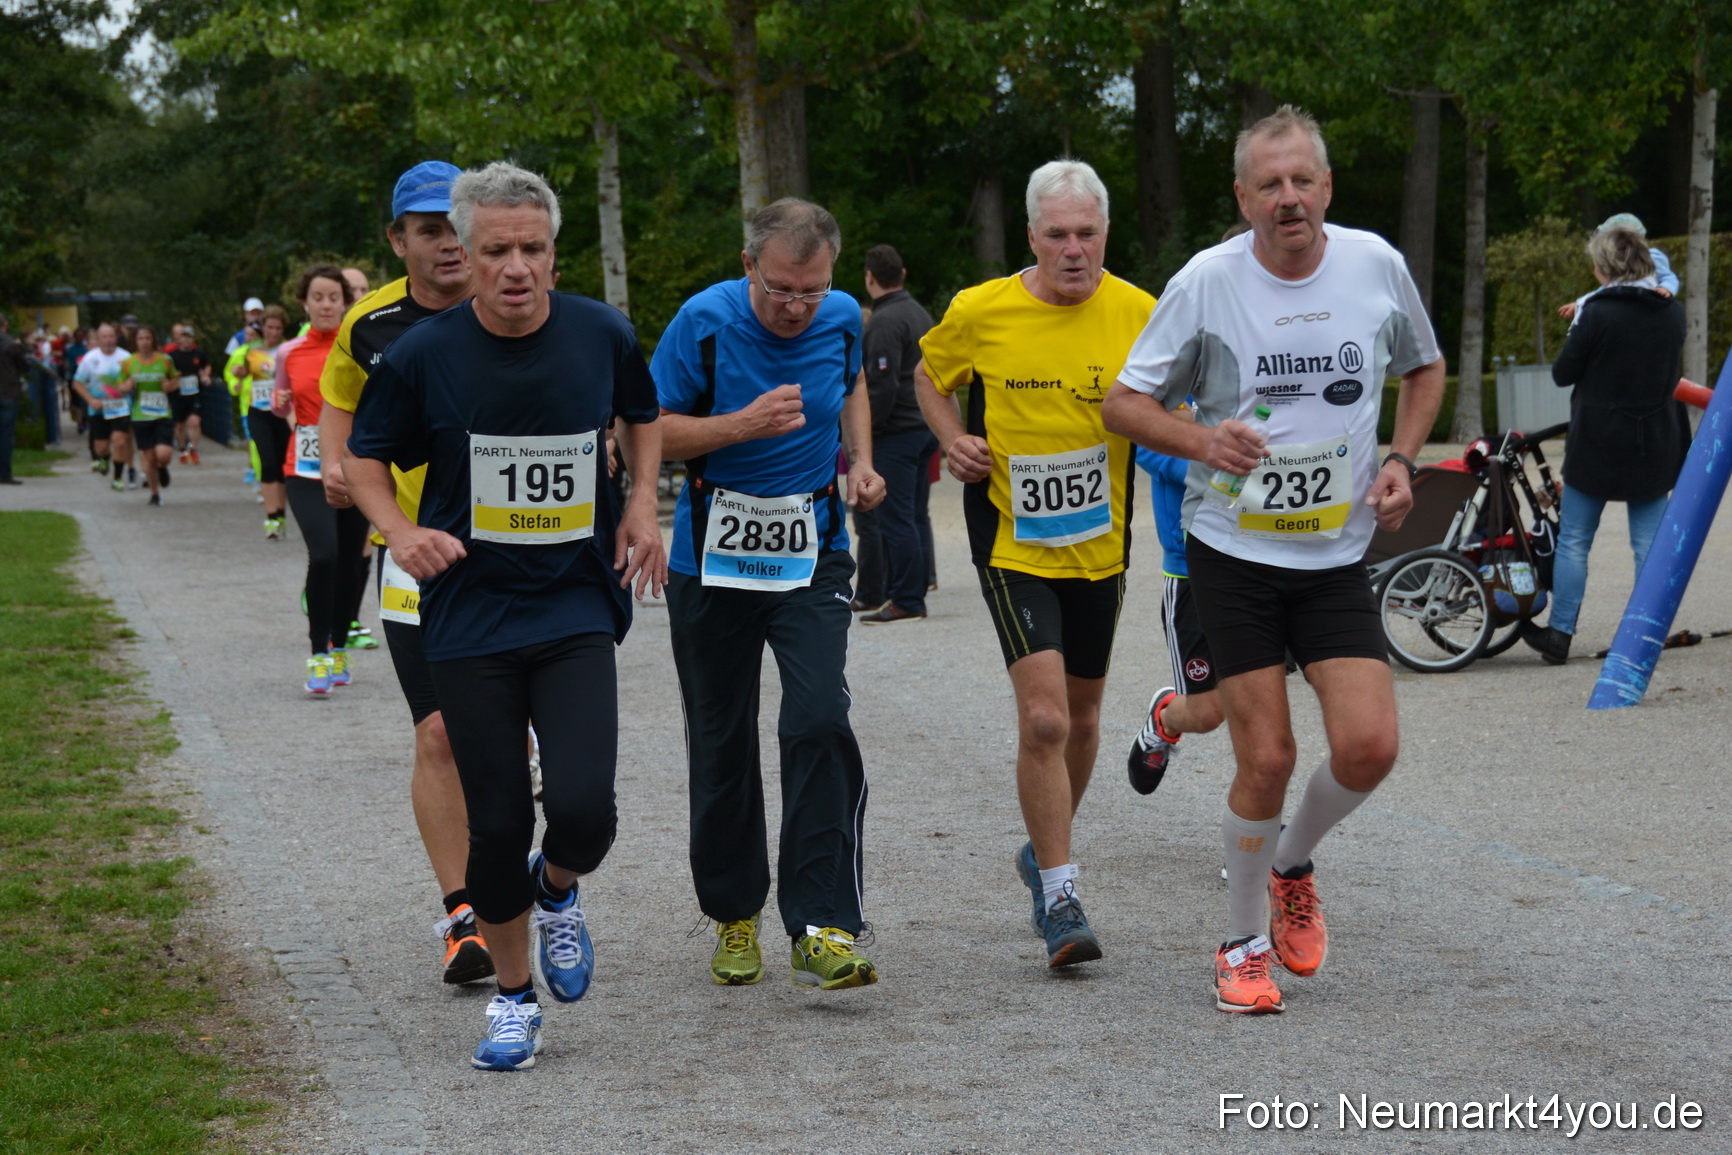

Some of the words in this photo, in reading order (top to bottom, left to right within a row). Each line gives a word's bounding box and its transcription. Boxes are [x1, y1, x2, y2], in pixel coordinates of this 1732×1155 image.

[1274, 311, 1331, 326] orca
[1255, 352, 1335, 377] Allianz
[1005, 378, 1062, 389] Norbert
[1332, 382, 1358, 393] RADAU
[474, 446, 517, 458] PARTL
[519, 446, 579, 458] Neumarkt
[1278, 450, 1333, 467] Neumarkt
[1011, 464, 1045, 473] PARTL
[1047, 457, 1096, 473] Neumarkt
[498, 463, 575, 503] 195
[1021, 468, 1103, 513] 3052
[1262, 466, 1332, 510] 232
[714, 496, 749, 514] PARTL
[750, 505, 800, 517] Neumarkt
[509, 513, 561, 529] Stefan
[1274, 517, 1320, 531] Georg
[716, 514, 809, 553] 2830
[736, 560, 784, 577] Volker
